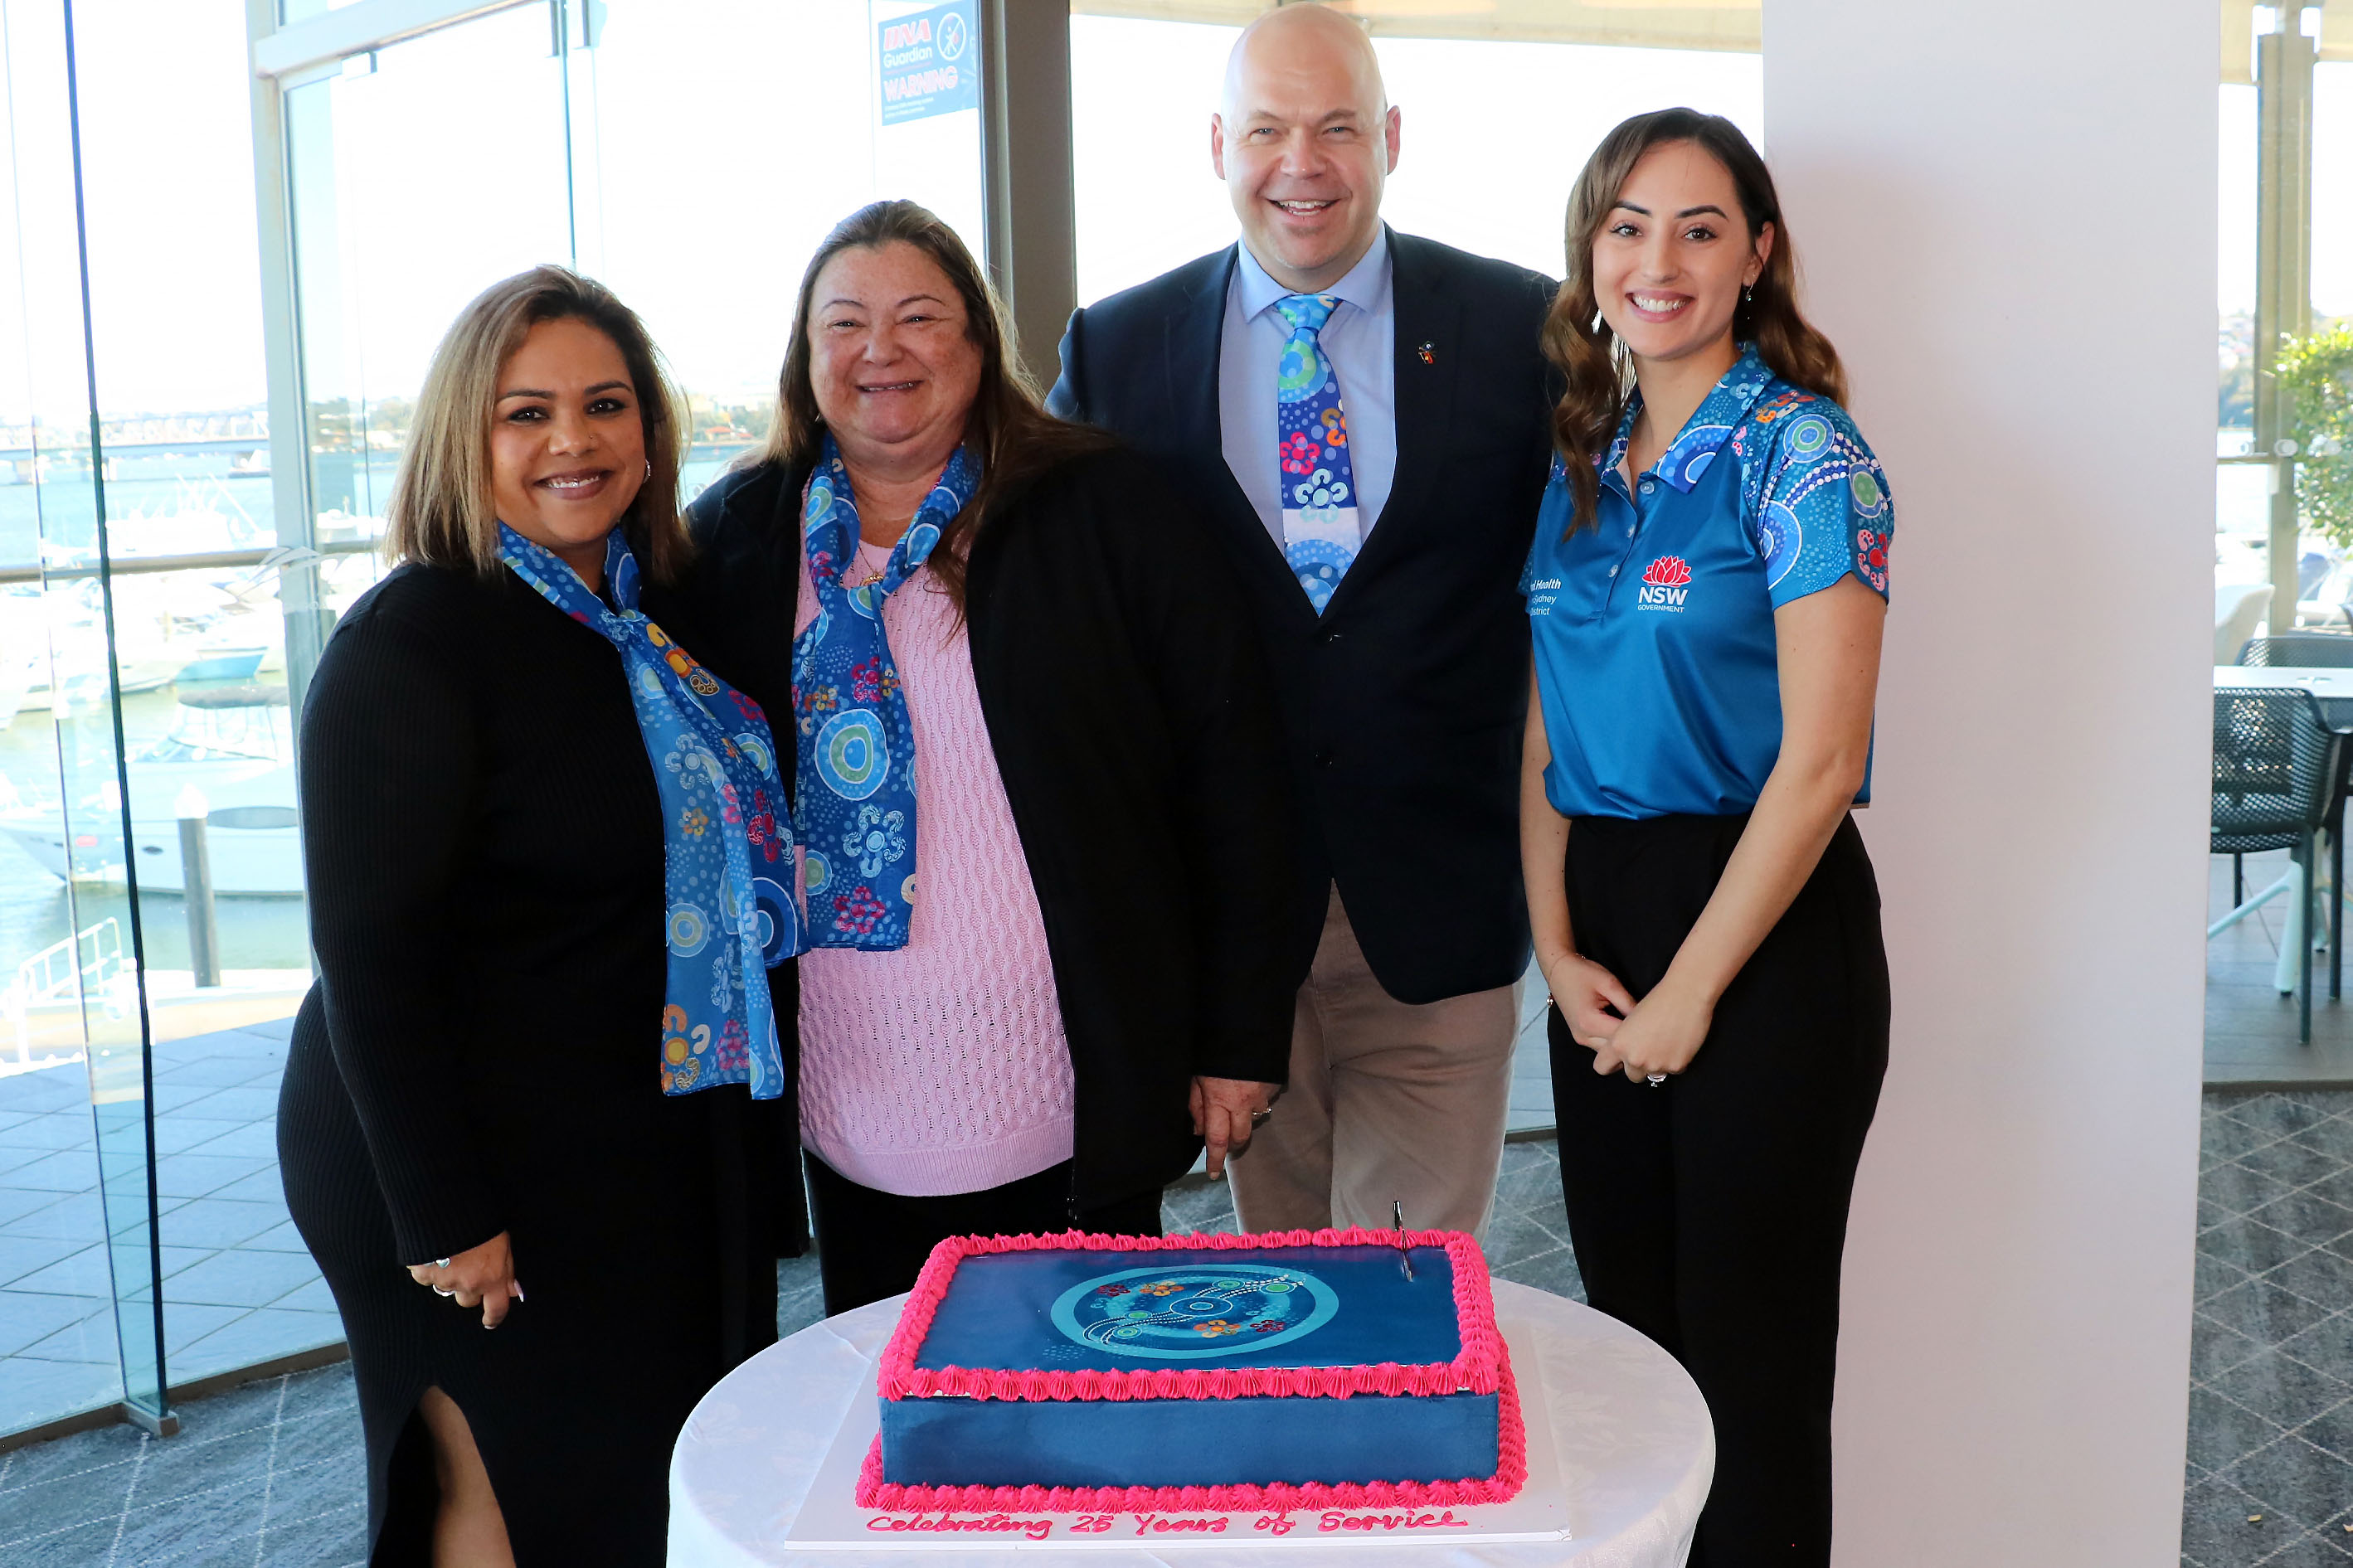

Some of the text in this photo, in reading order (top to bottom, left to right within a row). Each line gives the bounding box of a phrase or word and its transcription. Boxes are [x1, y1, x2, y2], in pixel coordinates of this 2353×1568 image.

[883, 46, 933, 68] Guardian
[883, 66, 958, 103] WARNING
[1534, 578, 1562, 590] Health
[1638, 586, 1689, 606] NSW
[1637, 604, 1685, 614] GOVERNMENT
[866, 1510, 1468, 1540] Celebrating 25 Years of Service
